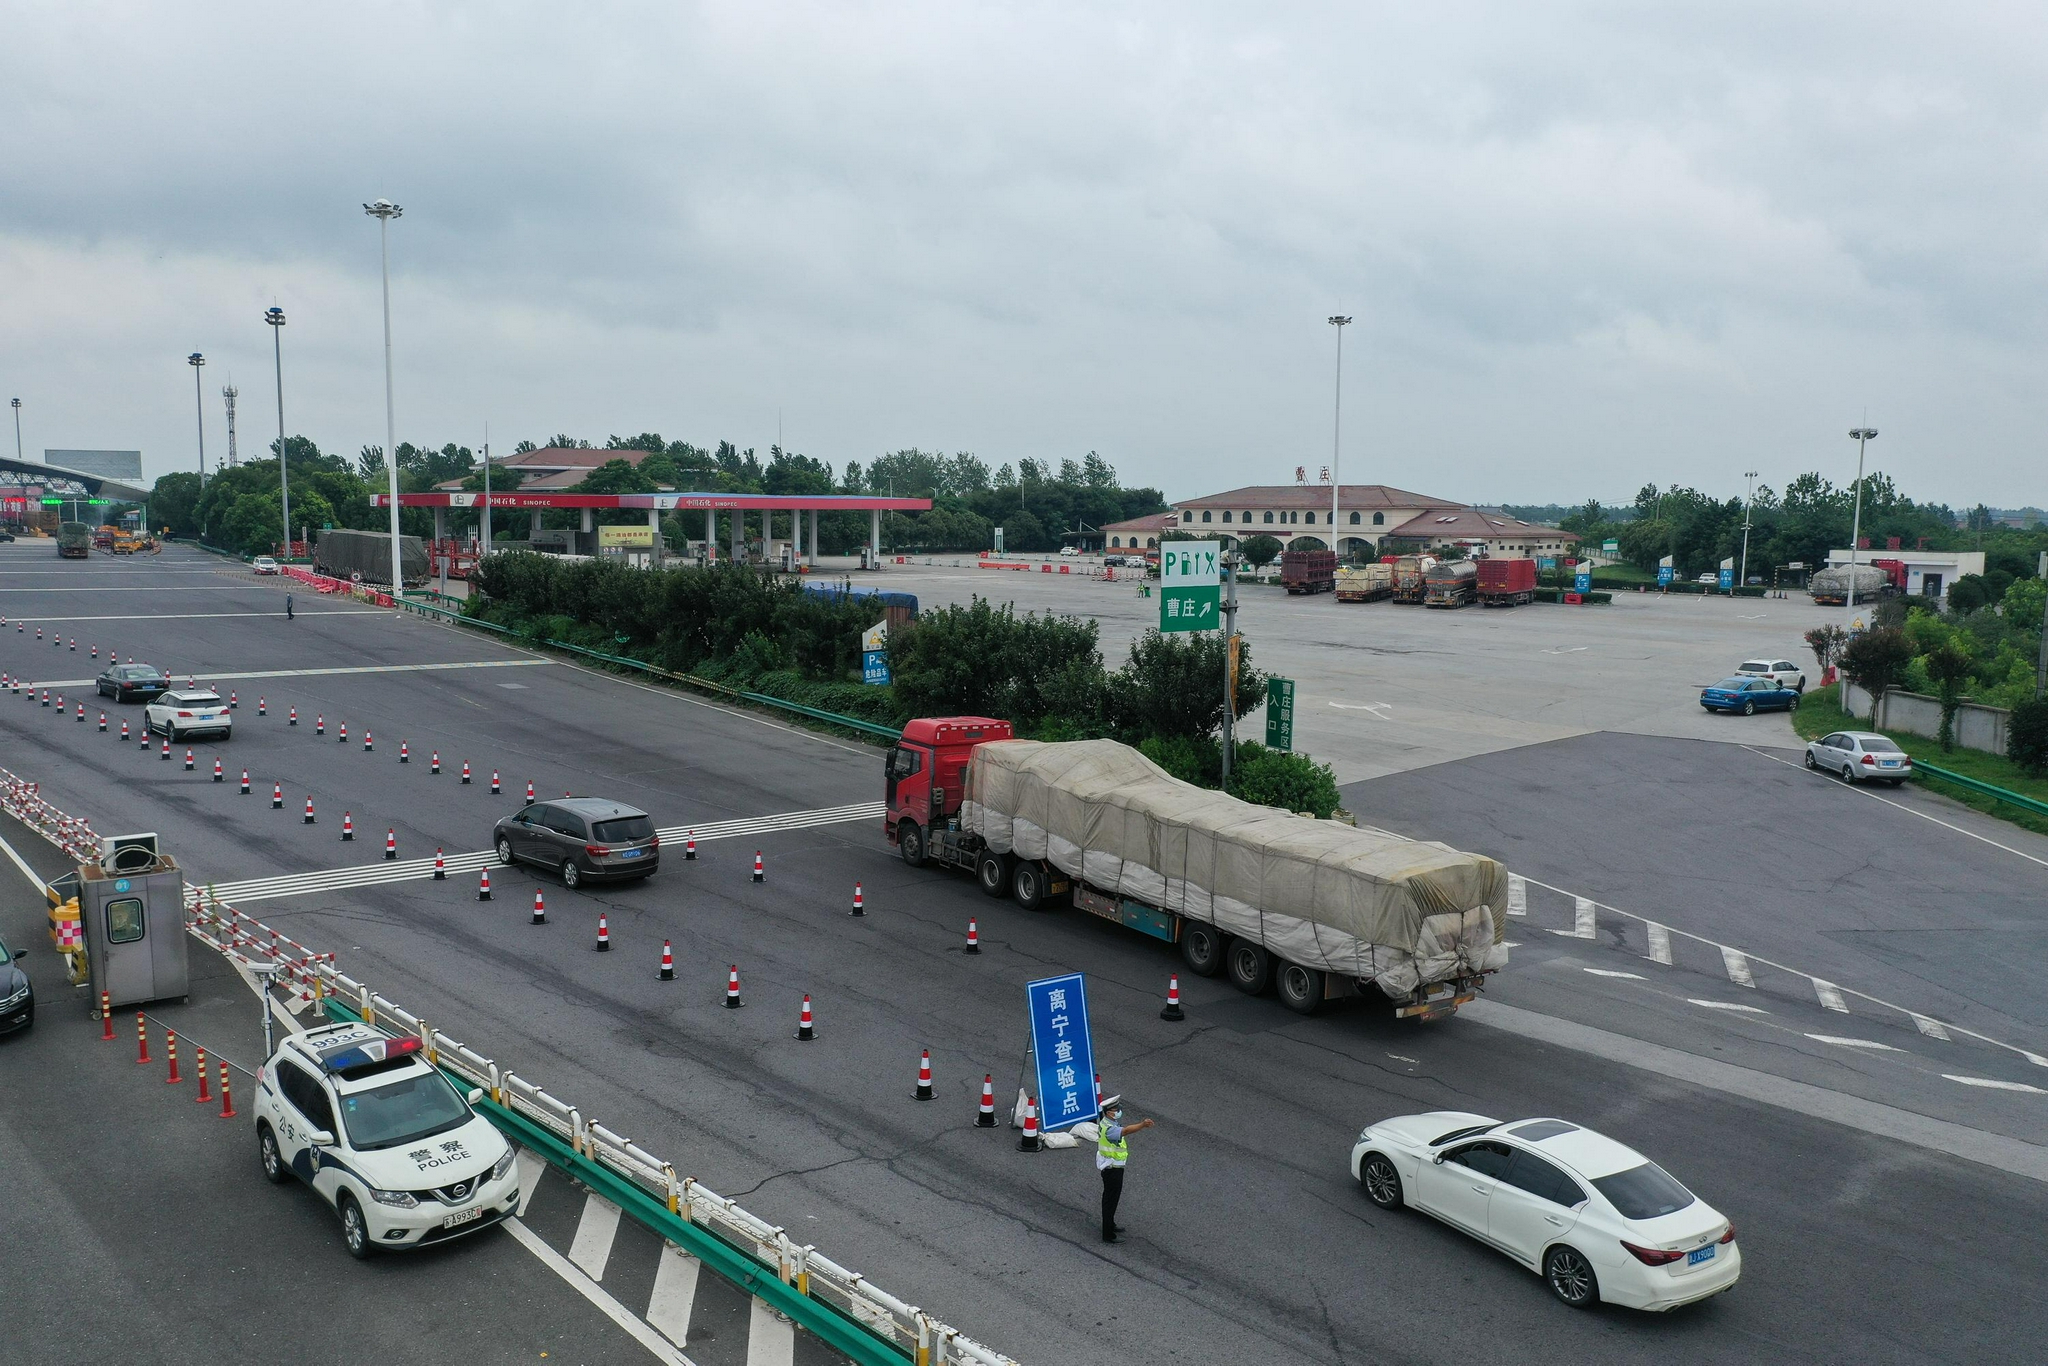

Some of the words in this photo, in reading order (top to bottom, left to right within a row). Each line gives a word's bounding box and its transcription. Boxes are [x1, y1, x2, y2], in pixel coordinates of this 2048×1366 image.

[1295, 466, 1329, 480] 曹庄
[686, 499, 711, 507] 中国石化
[1165, 552, 1176, 576] P
[1167, 598, 1196, 617] 曹庄
[869, 655, 876, 666] P
[1268, 695, 1279, 731] 入口
[1280, 682, 1292, 748] 曹庄服务区
[312, 1031, 368, 1048] 993C
[1048, 988, 1080, 1116] 离宁查验点
[280, 1116, 295, 1143] 公安
[408, 1140, 464, 1163] 警察
[418, 1150, 472, 1172] POLICE
